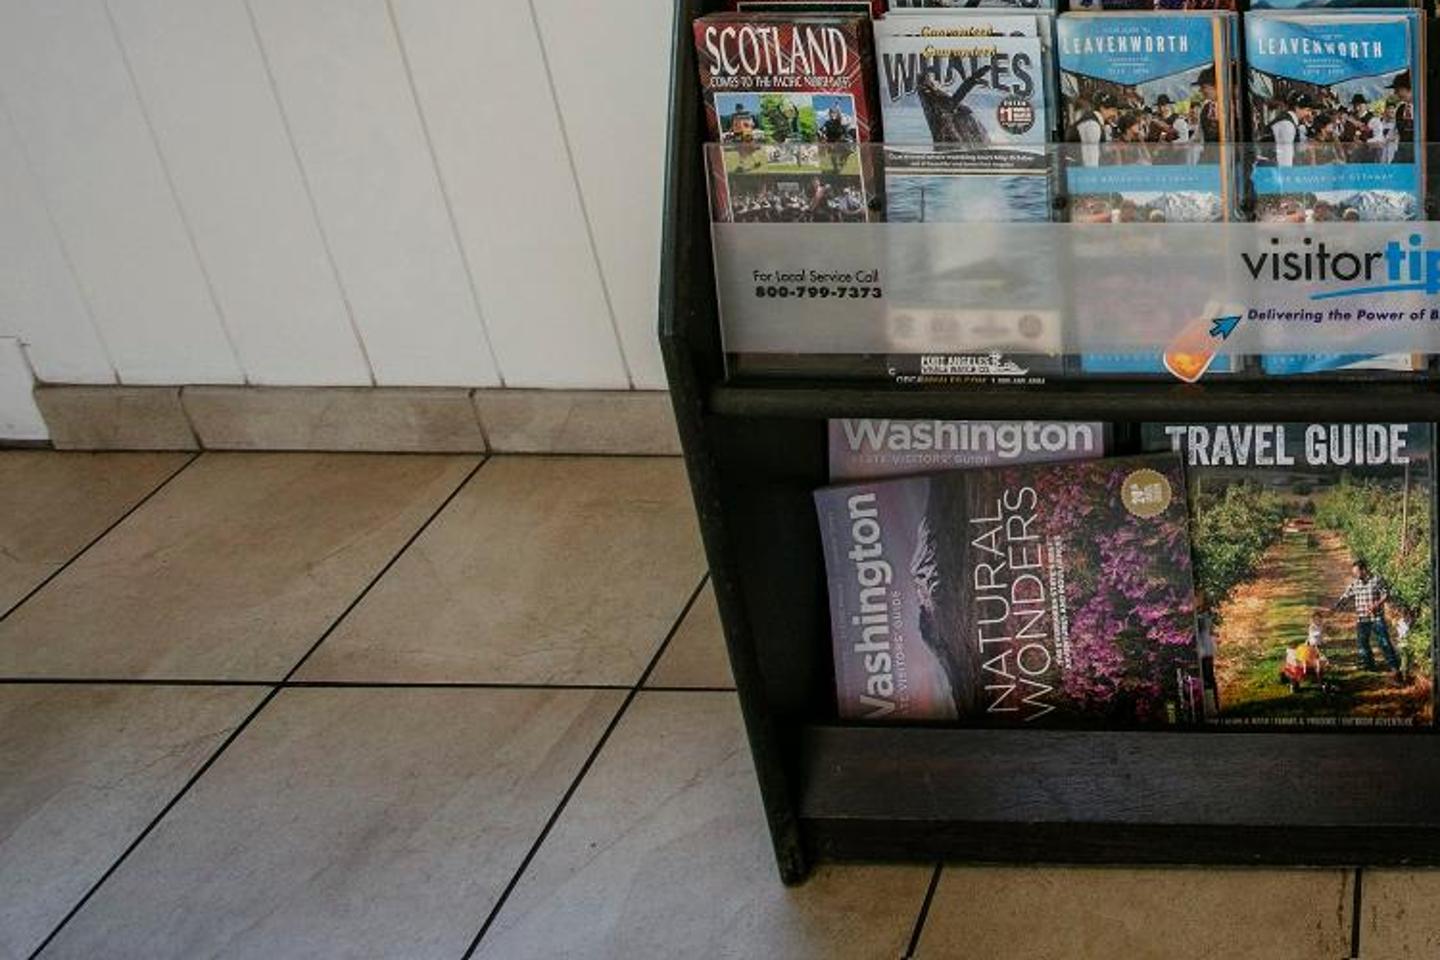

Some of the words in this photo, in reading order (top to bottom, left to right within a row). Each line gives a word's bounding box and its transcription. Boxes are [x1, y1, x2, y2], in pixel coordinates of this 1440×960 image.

[706, 26, 849, 77] SCOTLAND
[1063, 35, 1189, 56] LEAVENWORTH
[883, 53, 1035, 102] WHALES
[753, 270, 772, 282] For
[775, 269, 806, 283] Local
[810, 270, 851, 283] Service
[855, 270, 879, 283] Call
[755, 286, 882, 299] 800-799-7373
[1248, 308, 1323, 323] Delivering
[1328, 308, 1351, 321] the
[1357, 309, 1403, 321] Power
[1410, 308, 1425, 321] of
[844, 420, 1093, 458] Washington
[1165, 424, 1294, 466] TRAVEL
[1305, 424, 1410, 466] GUIDE
[970, 499, 1019, 713] NATURAL
[1004, 486, 1056, 722] WONDERS
